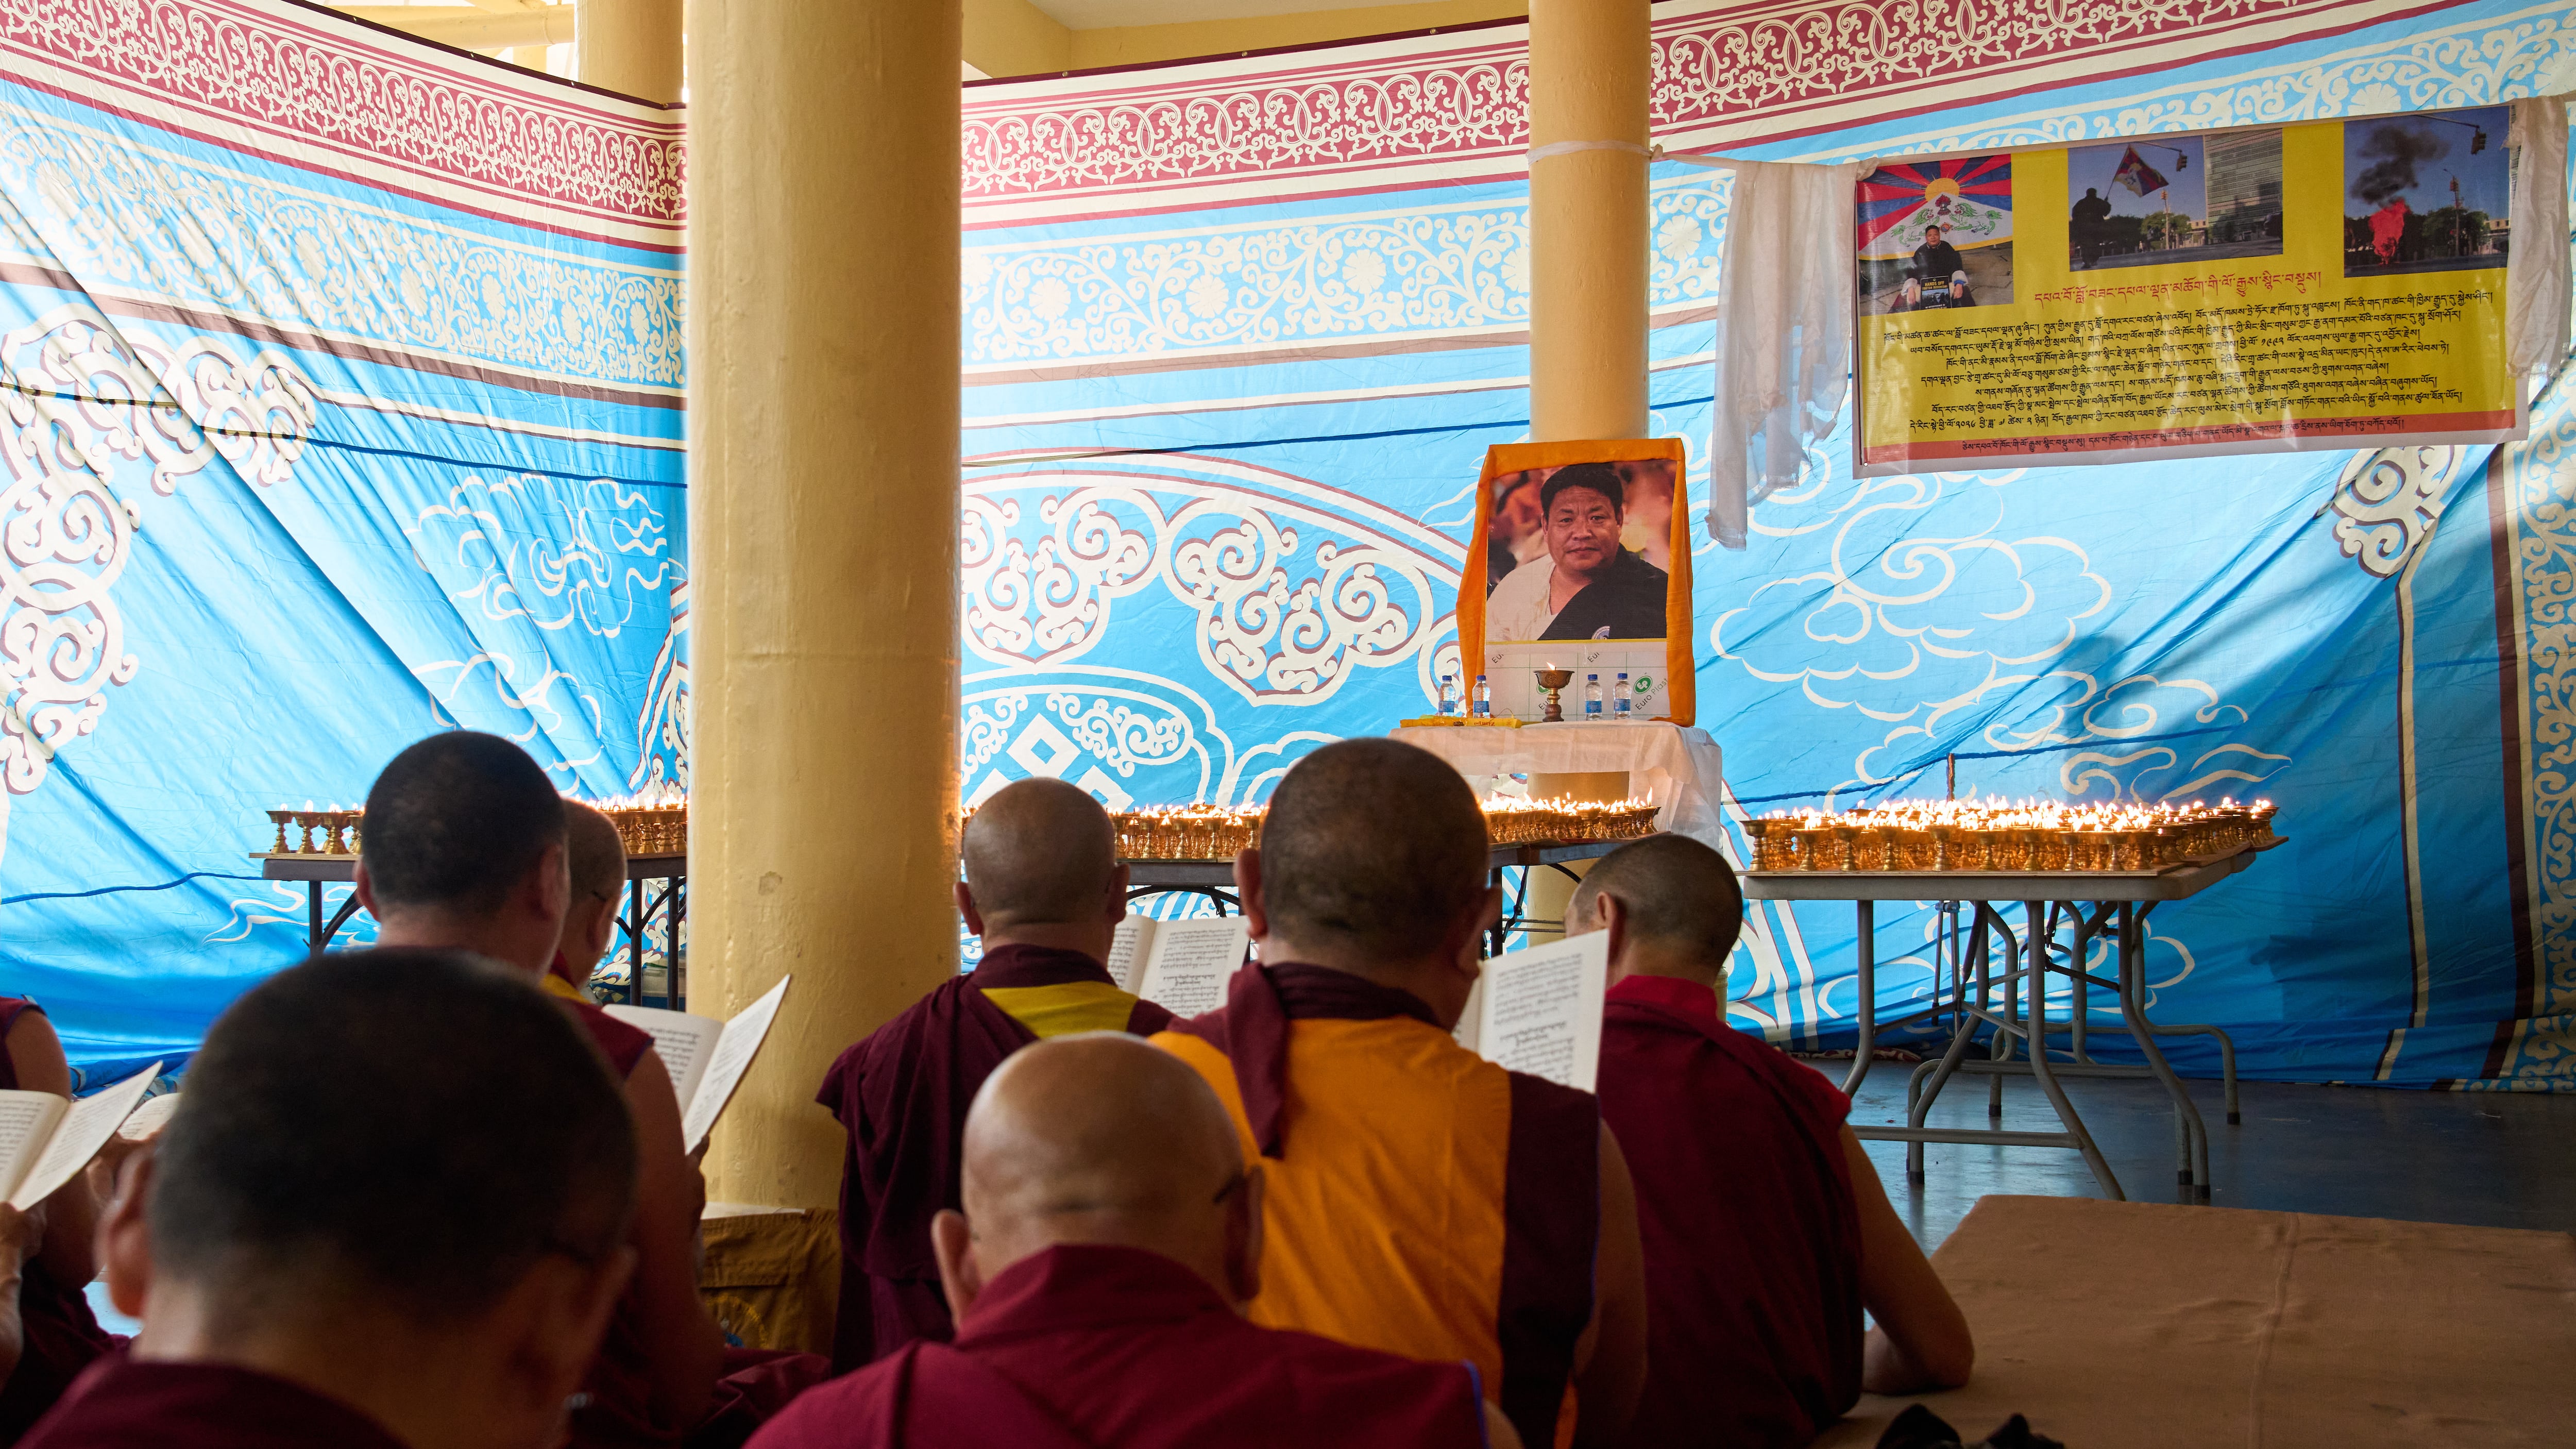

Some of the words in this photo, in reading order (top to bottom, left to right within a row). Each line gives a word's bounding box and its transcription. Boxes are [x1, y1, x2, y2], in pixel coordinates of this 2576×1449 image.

[2261, 336, 2284, 346] ༡༩༩༢
[2027, 416, 2032, 425] ༢
[1492, 654, 1504, 663] Eu
[1635, 695, 1652, 710] Euro
